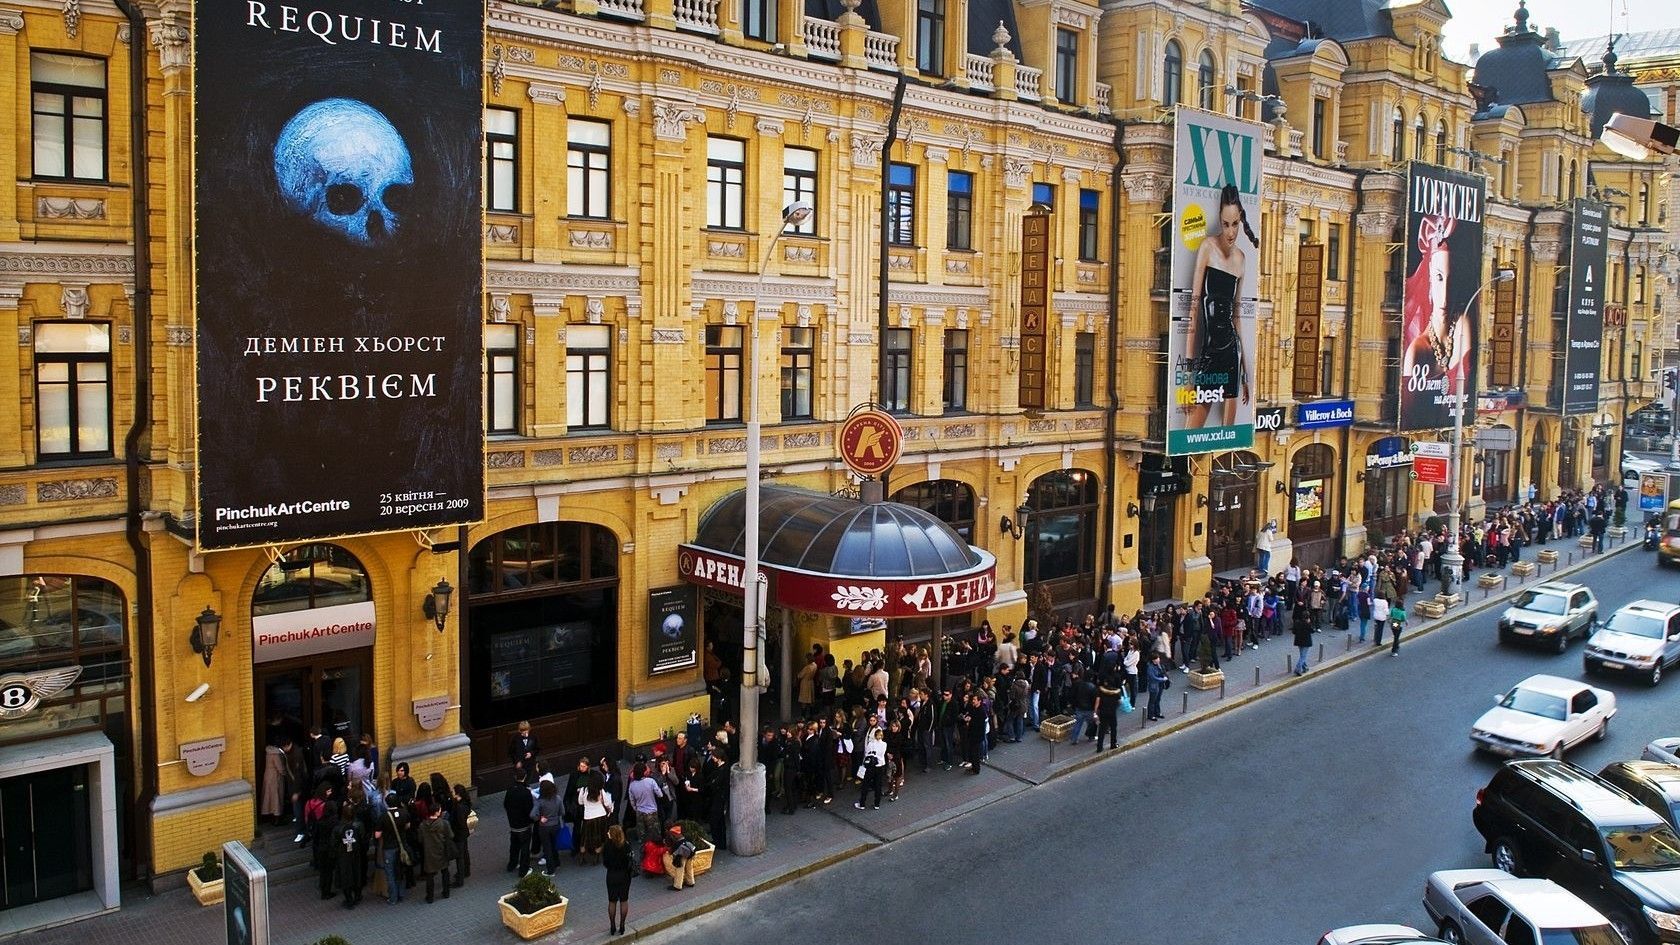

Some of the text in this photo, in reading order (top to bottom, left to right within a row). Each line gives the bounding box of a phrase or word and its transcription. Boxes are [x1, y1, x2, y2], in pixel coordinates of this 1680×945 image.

[246, 0, 443, 54] REQUIEM
[1183, 124, 1258, 195] XXL
[1414, 175, 1481, 223] L'OFFICIEL
[1027, 219, 1039, 304] АРЕНА
[244, 336, 446, 357] ДЕМІЕН ХЬОРСТ
[256, 373, 437, 403] РЕКВІЄМ
[1408, 363, 1430, 392] 88
[1255, 410, 1281, 431] DRÓ
[1305, 407, 1352, 422] Villeroy & Boch
[1187, 430, 1236, 444] www.xxl.ua
[380, 493, 393, 504] 25
[395, 490, 434, 502] квітня
[380, 498, 470, 517] 20 вересня 2009
[216, 499, 351, 521] PinchukArtCentre
[216, 520, 279, 532] pinchukartcentre.org
[921, 576, 990, 610] АРЕНА
[259, 621, 373, 646] PinchukArtCentre
[2, 687, 26, 708] B
